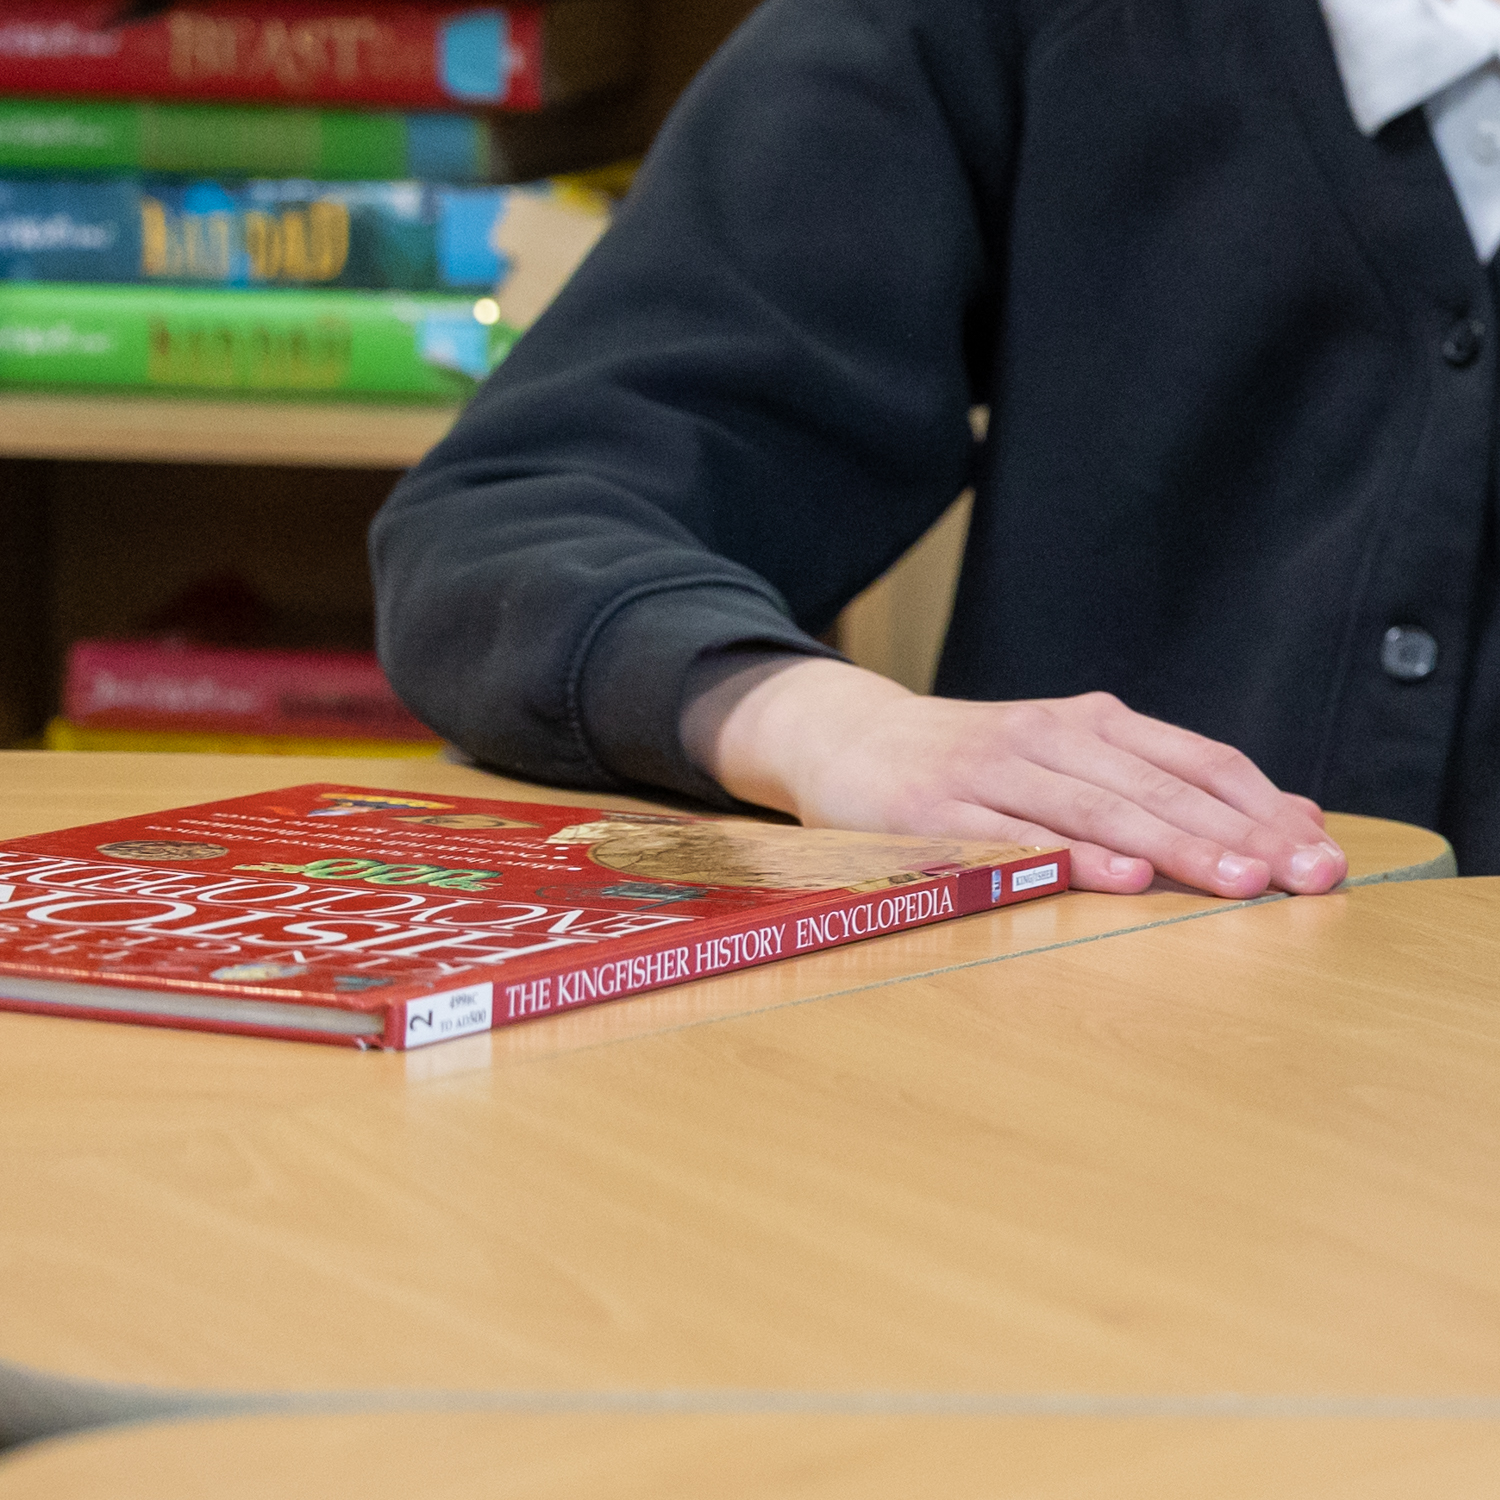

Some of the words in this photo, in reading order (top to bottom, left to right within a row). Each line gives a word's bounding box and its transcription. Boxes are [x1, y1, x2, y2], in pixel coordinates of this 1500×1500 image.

[505, 977, 552, 1018] THE
[556, 946, 691, 1007] KINGFISHER
[694, 923, 787, 974] HISTORY
[795, 885, 956, 950] ENCYCLOPEDIA
[410, 1009, 433, 1032] 2
